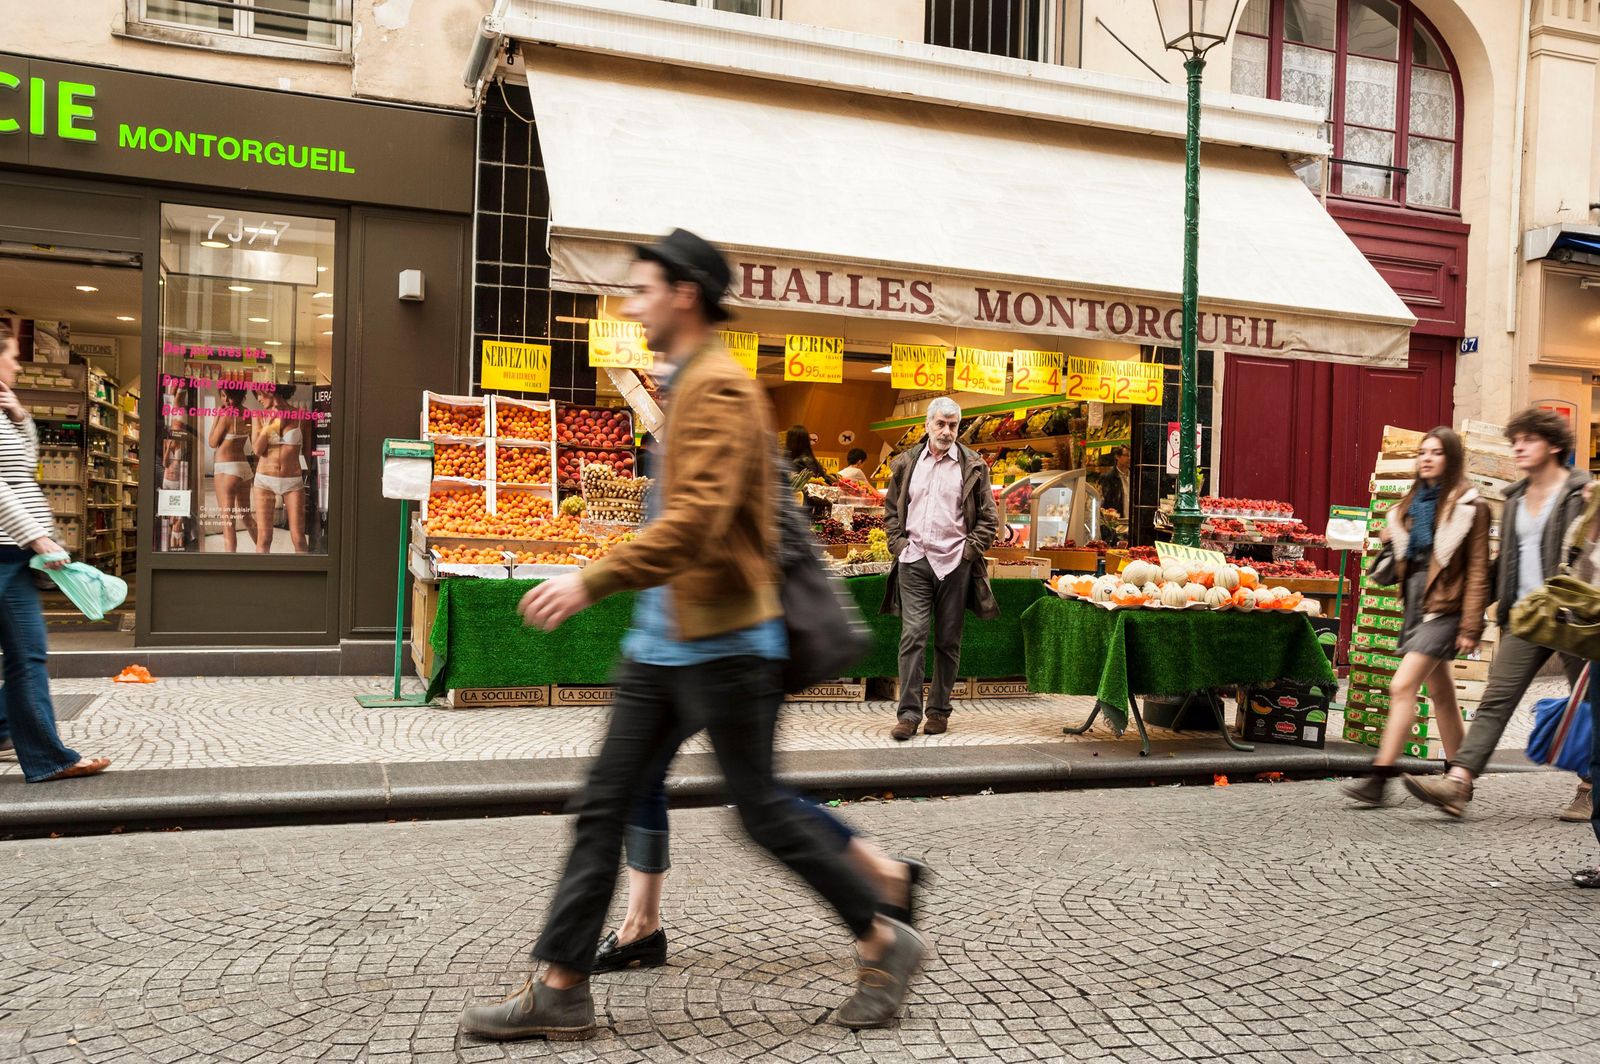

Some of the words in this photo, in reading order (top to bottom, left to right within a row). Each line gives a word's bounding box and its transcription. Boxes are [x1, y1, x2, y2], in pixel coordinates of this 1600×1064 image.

[119, 124, 356, 174] MONTORGUEIL
[739, 263, 936, 315] HALLES
[974, 287, 1286, 350] MONTORGUEIL
[595, 322, 643, 339] ABRICO
[71, 343, 113, 355] OMOTIONS
[163, 341, 187, 355] Des
[189, 345, 214, 359] prix
[245, 347, 267, 360] bas
[788, 336, 843, 354] CERISE
[1461, 337, 1477, 352] 67
[485, 345, 522, 369] SERVEZ
[524, 348, 548, 371] VOUS
[1016, 351, 1063, 368] FRAMBOISE
[1070, 358, 1087, 374] MARA
[1088, 360, 1100, 376] DES
[1116, 362, 1162, 379] GARIGUETTE
[162, 375, 185, 388] Des
[216, 377, 277, 392] étonnants
[1015, 367, 1030, 390] 2
[1047, 368, 1059, 393] 4
[1068, 374, 1083, 397] 2
[1099, 377, 1111, 400] 5
[315, 391, 332, 402] LIERA
[1116, 377, 1130, 399] 2
[1146, 379, 1159, 402] 5
[162, 404, 184, 417] Des
[188, 405, 240, 418] conseils
[464, 692, 478, 701] LA
[481, 691, 540, 700] SOCULENTE
[562, 691, 575, 699] LA
[578, 690, 616, 699] SOCULE
[980, 686, 991, 694] LA
[993, 685, 1028, 693] SOCULEN
